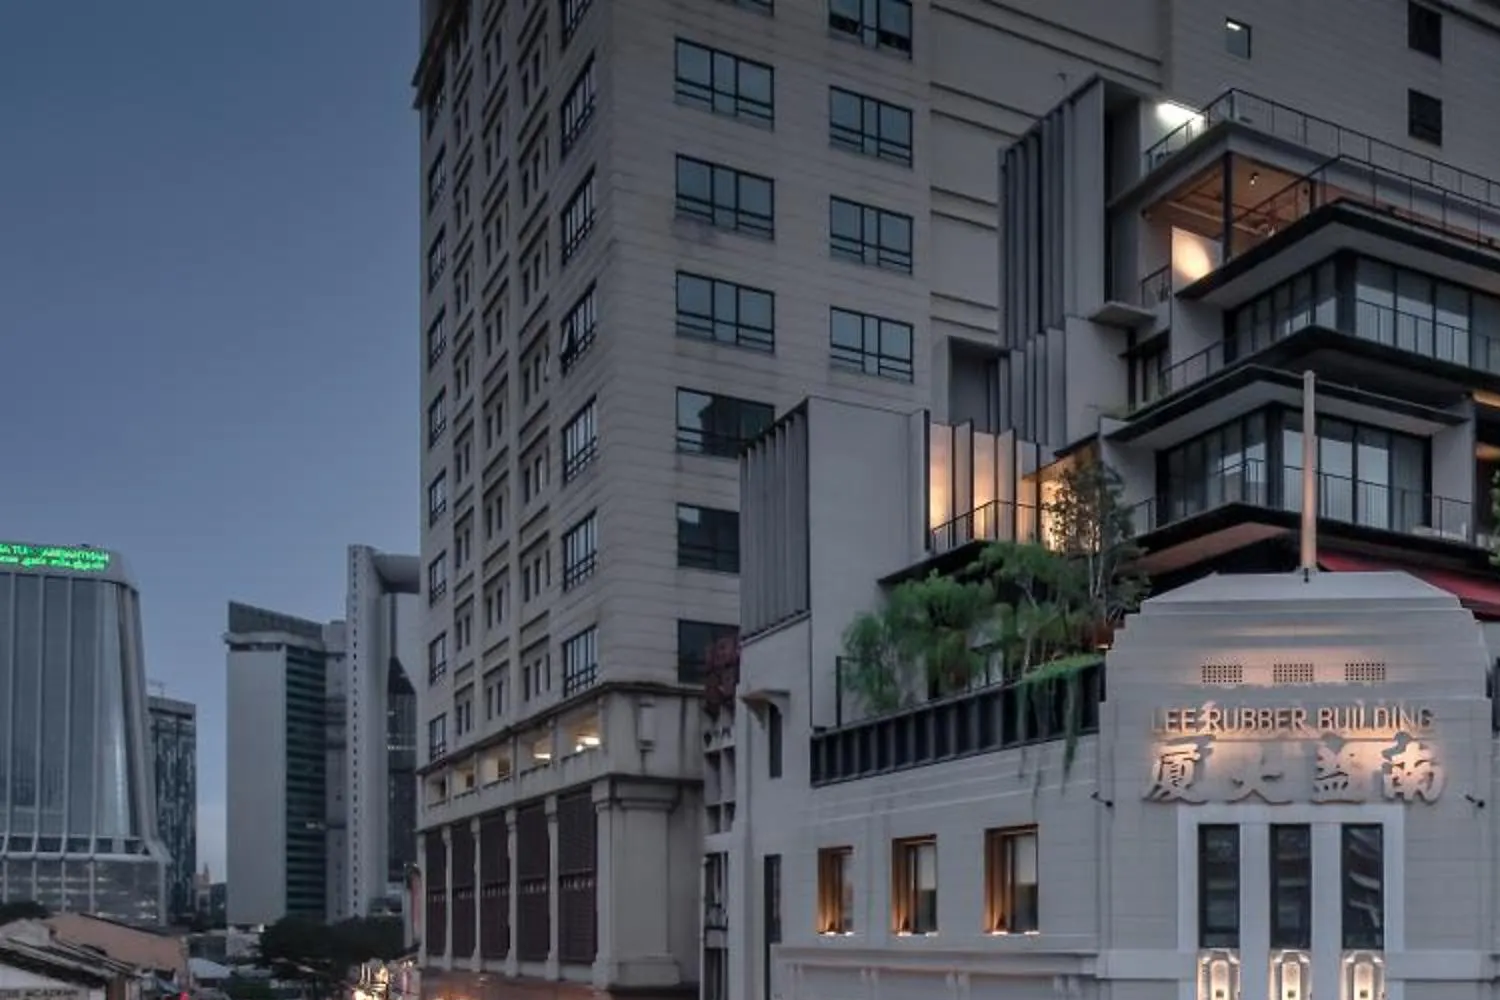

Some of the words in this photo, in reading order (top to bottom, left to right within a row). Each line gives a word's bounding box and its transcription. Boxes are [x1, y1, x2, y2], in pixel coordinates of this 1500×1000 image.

[1151, 707, 1197, 732] LEE
[1205, 707, 1308, 732] RUBBER
[1316, 707, 1435, 732] BUILDING
